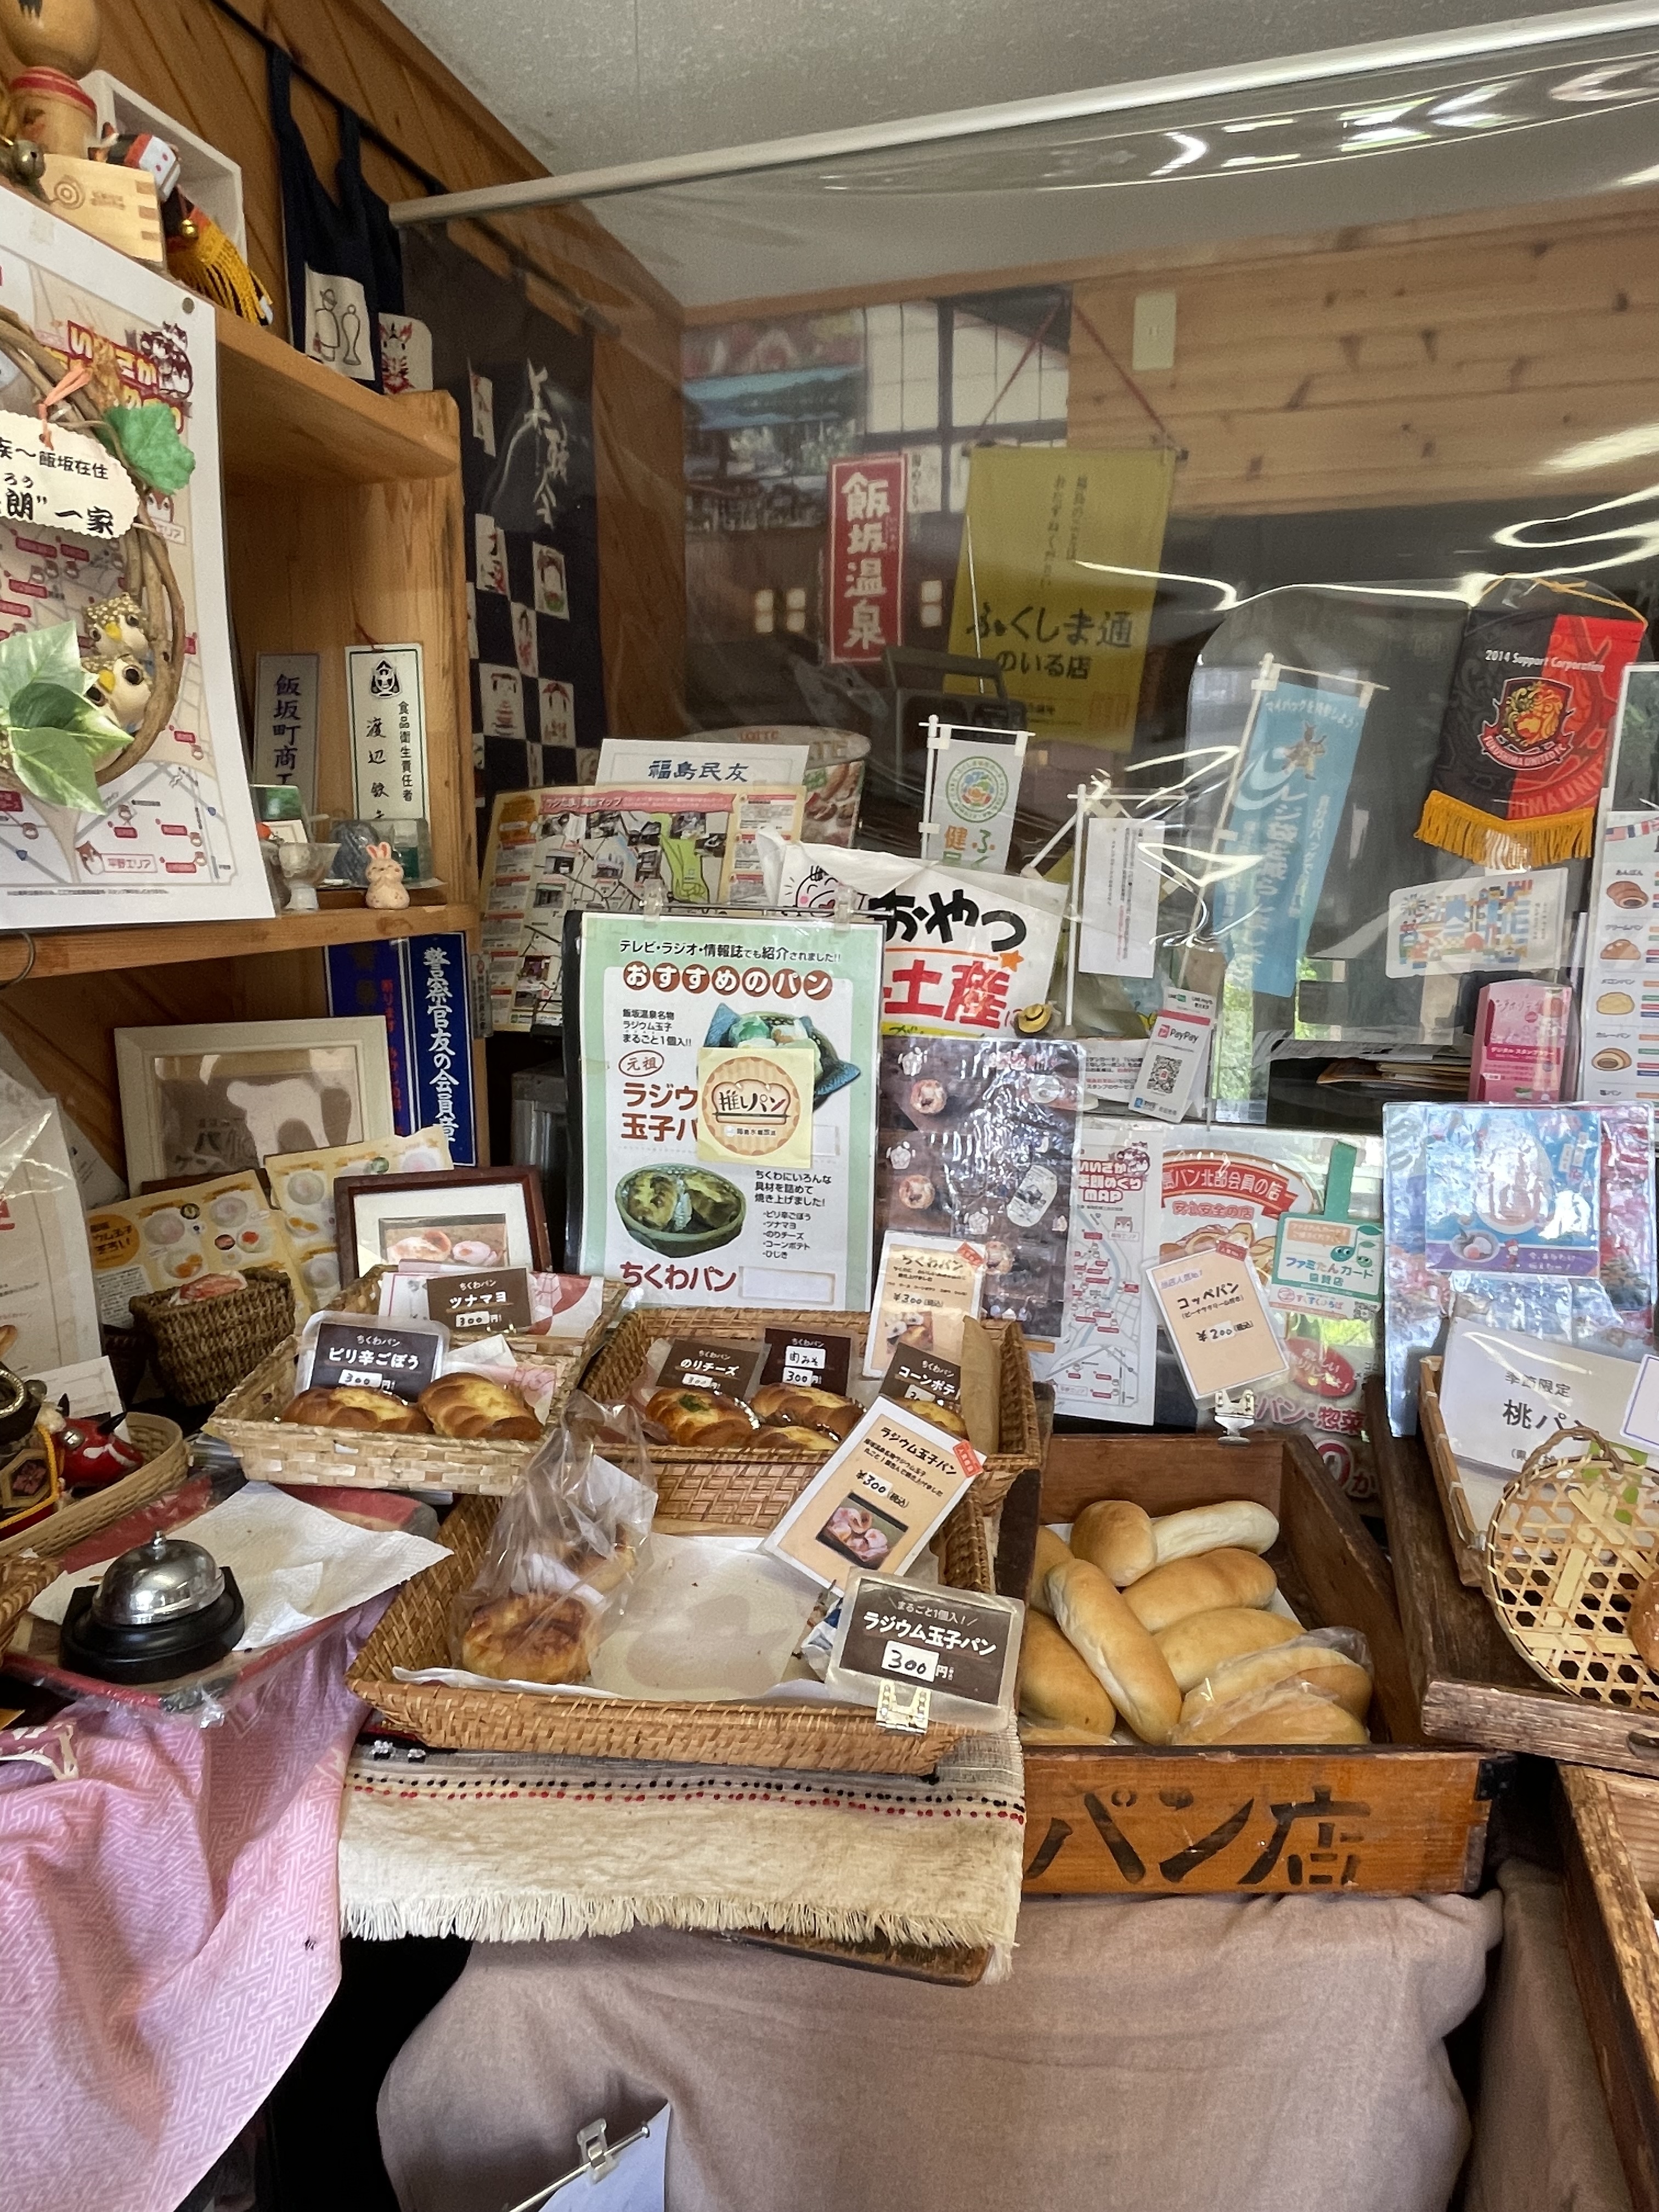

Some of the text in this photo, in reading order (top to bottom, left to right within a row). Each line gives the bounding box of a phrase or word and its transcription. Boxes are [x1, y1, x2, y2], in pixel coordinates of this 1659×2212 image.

[840, 471, 891, 650] 飯坂温泉
[966, 601, 1132, 648] ふくしま通
[996, 650, 1093, 680] のいる店
[1485, 650, 1606, 673] 2014 Support Corporation
[648, 759, 749, 782] 福島民友
[868, 888, 1027, 952] おやつ
[625, 963, 832, 998] おすすめのパン
[883, 959, 1011, 1029] 土産
[622, 1008, 675, 1021] 飯坂温泉名物
[623, 1020, 673, 1032] ラジウム玉子
[1170, 1028, 1199, 1043] PayPay
[627, 1057, 658, 1071] 元祖
[719, 1089, 787, 1113] 推しパン
[755, 1170, 832, 1184] ちくわにいろんな
[755, 1181, 814, 1195] 具材を詰めて
[1172, 1200, 1255, 1221] 安心安全の店
[459, 1279, 496, 1291] ちくわパン
[619, 1261, 737, 1292] ちくわパン
[449, 1290, 506, 1310] ツナマヨ
[1177, 1282, 1239, 1310] コッペパン
[356, 1334, 400, 1347] ちくわパン
[791, 1337, 825, 1348] ちくわパン
[329, 1346, 420, 1370] ピリ辛ごぼう
[680, 1358, 740, 1376] のりチーズ
[698, 1350, 731, 1361] ちくわパン
[879, 1426, 957, 1476] ラジウム玉子パン
[863, 1611, 997, 1656] ラジウム玉子パン
[1024, 1784, 1372, 1886] パン店
